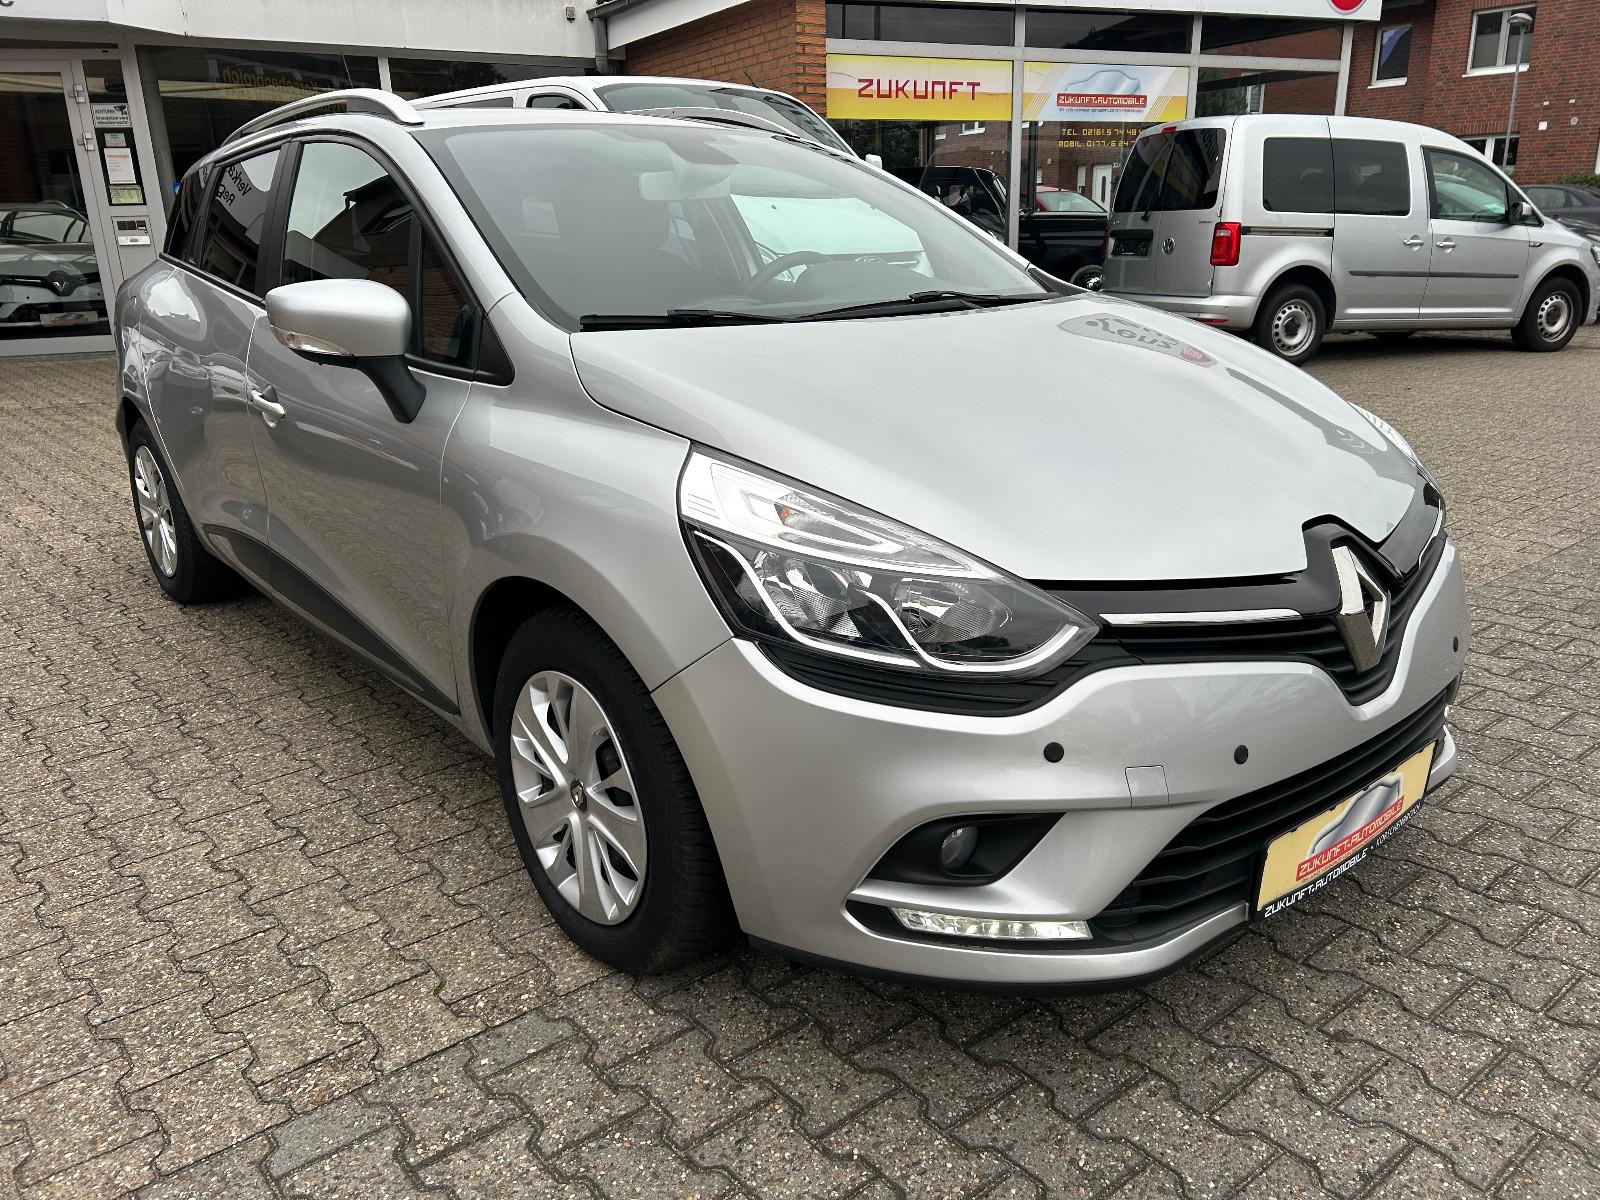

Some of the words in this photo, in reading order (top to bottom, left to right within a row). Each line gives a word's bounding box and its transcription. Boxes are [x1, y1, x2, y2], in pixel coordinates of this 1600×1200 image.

[857, 78, 981, 101] ZUKUNFT
[1059, 95, 1145, 105] ZUKUNFT.AUTOMOBILE
[1061, 128, 1080, 136] TEL.
[1126, 128, 1137, 136] 48
[1118, 140, 1129, 148] 24
[1298, 801, 1403, 877] ZUKUNFT.AUTOMOBILE
[1264, 847, 1369, 918] ZUKUNFT.AUTOMOBILE
